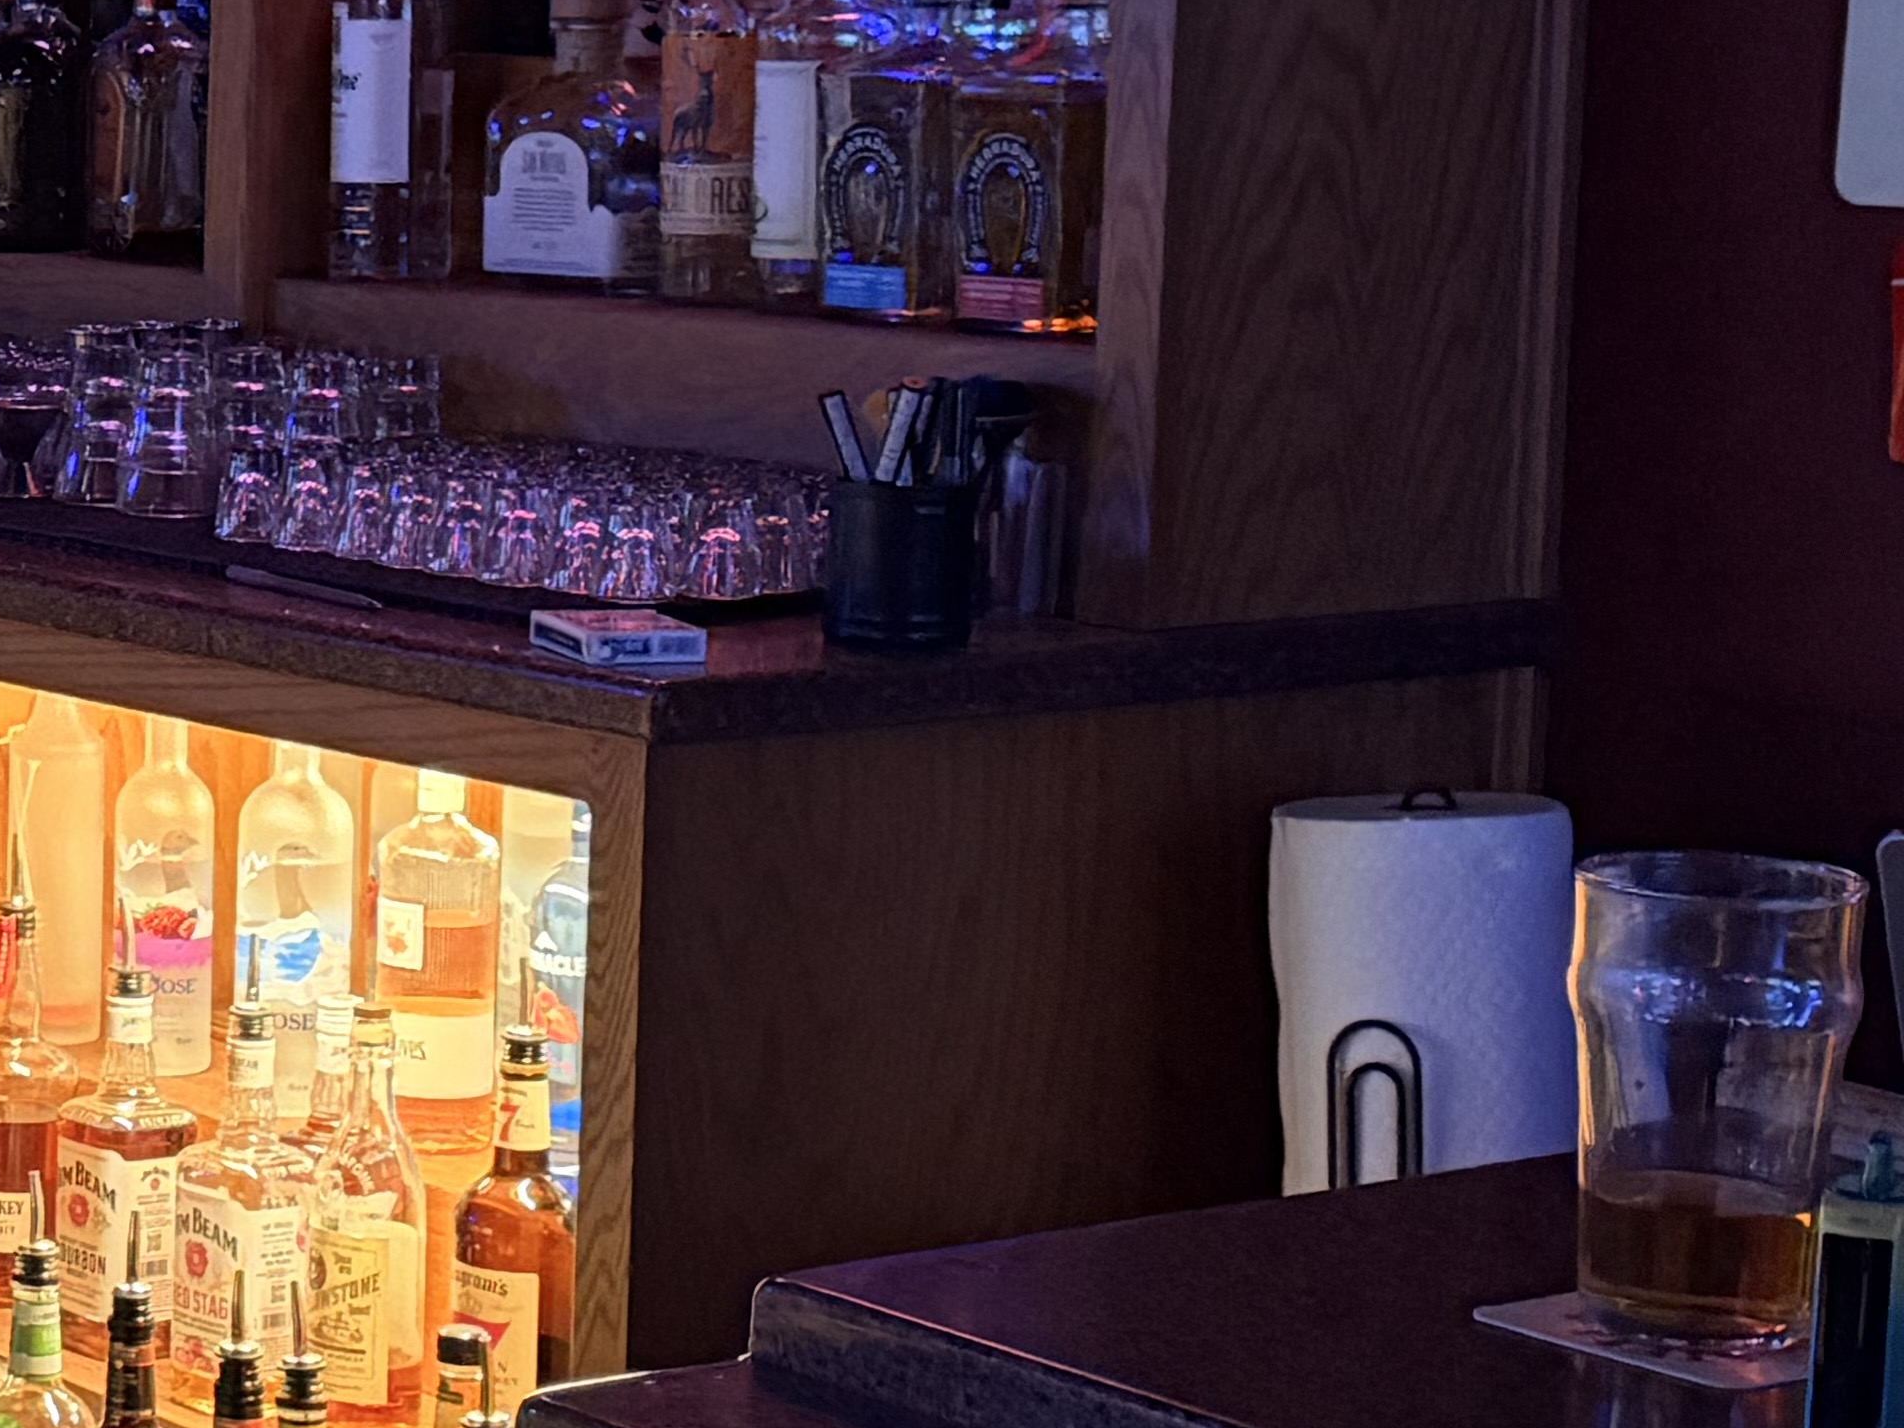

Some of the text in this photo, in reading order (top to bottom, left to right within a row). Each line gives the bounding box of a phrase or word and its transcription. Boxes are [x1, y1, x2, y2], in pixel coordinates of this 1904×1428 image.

[499, 1101, 520, 1143] 7
[75, 1160, 118, 1213] BEAM
[192, 1207, 239, 1262] BEAM
[193, 1294, 229, 1320] STAG
